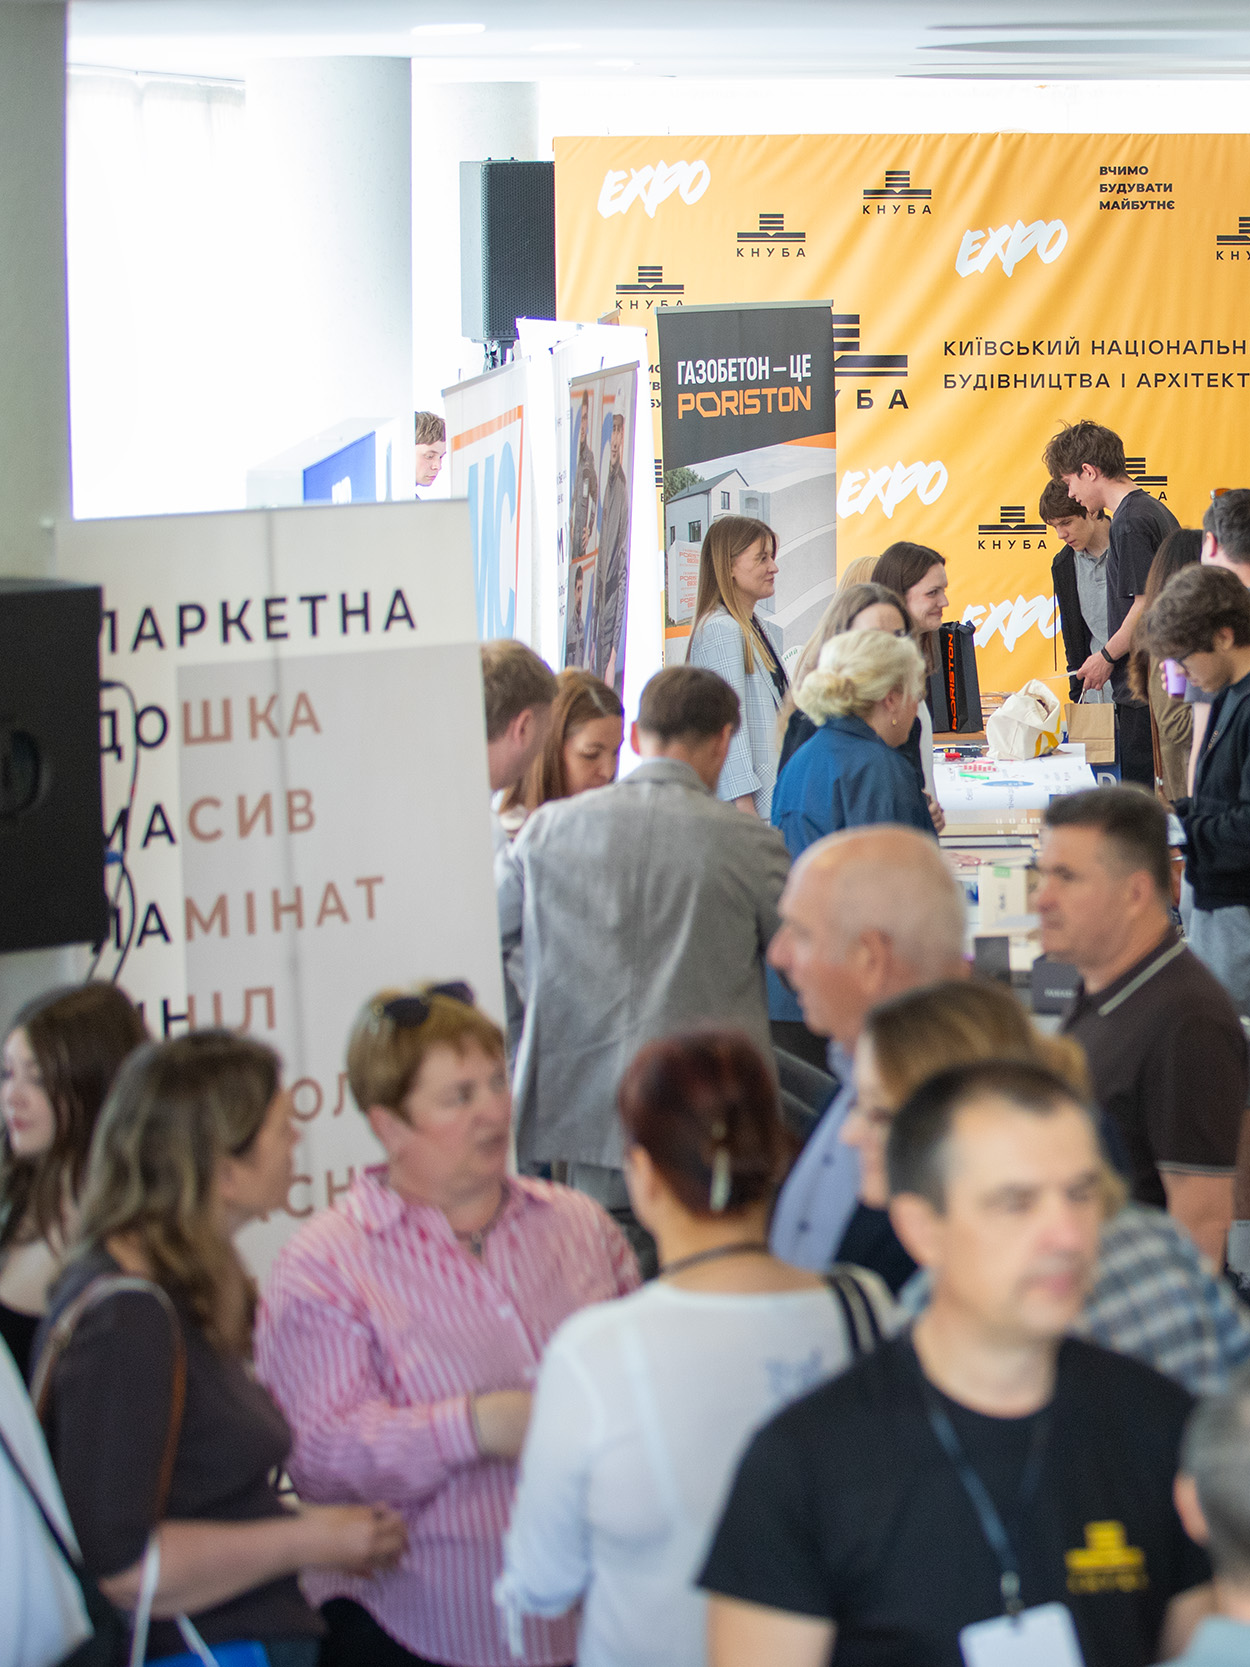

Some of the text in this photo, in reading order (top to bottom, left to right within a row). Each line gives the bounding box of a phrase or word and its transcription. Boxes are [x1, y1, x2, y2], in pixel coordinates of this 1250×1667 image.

[1099, 165, 1149, 176] ВЧИМО
[597, 160, 711, 218] EXPO
[1099, 183, 1174, 195] БУДУВАТИ
[862, 204, 932, 215] КНУБА
[1099, 197, 1176, 210] МАЙБУТНЄ
[736, 247, 806, 258] КНУБА
[955, 219, 1069, 277] EXPO
[944, 336, 1080, 356] КИЇВСЬКИЙ
[677, 356, 769, 385] ГАЗОБЕТОН
[790, 354, 812, 382] ЦЕ
[944, 373, 1110, 391] БУДІВНИЦТВА
[1121, 373, 1126, 388] І
[677, 385, 811, 420] PORISTON
[837, 460, 949, 519] EXPO
[977, 539, 1047, 550] КНУБА
[947, 633, 957, 731] PORISTON
